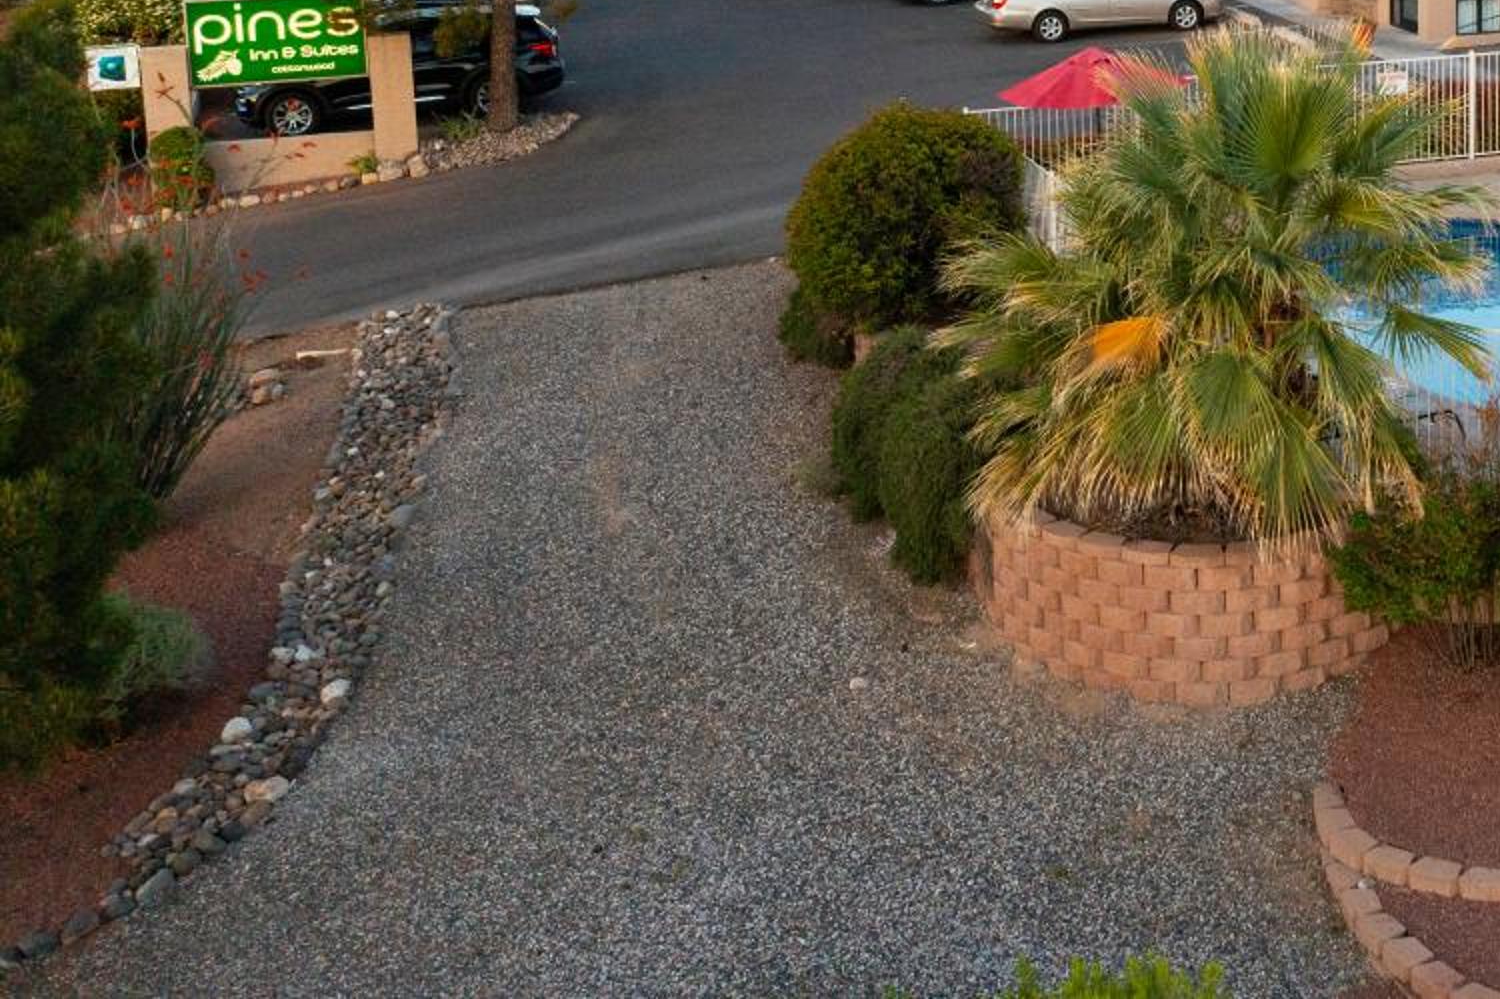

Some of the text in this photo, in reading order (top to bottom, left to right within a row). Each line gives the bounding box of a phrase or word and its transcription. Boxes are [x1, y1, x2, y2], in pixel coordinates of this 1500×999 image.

[193, 3, 360, 55] pines
[249, 44, 359, 61] Inn & Suites
